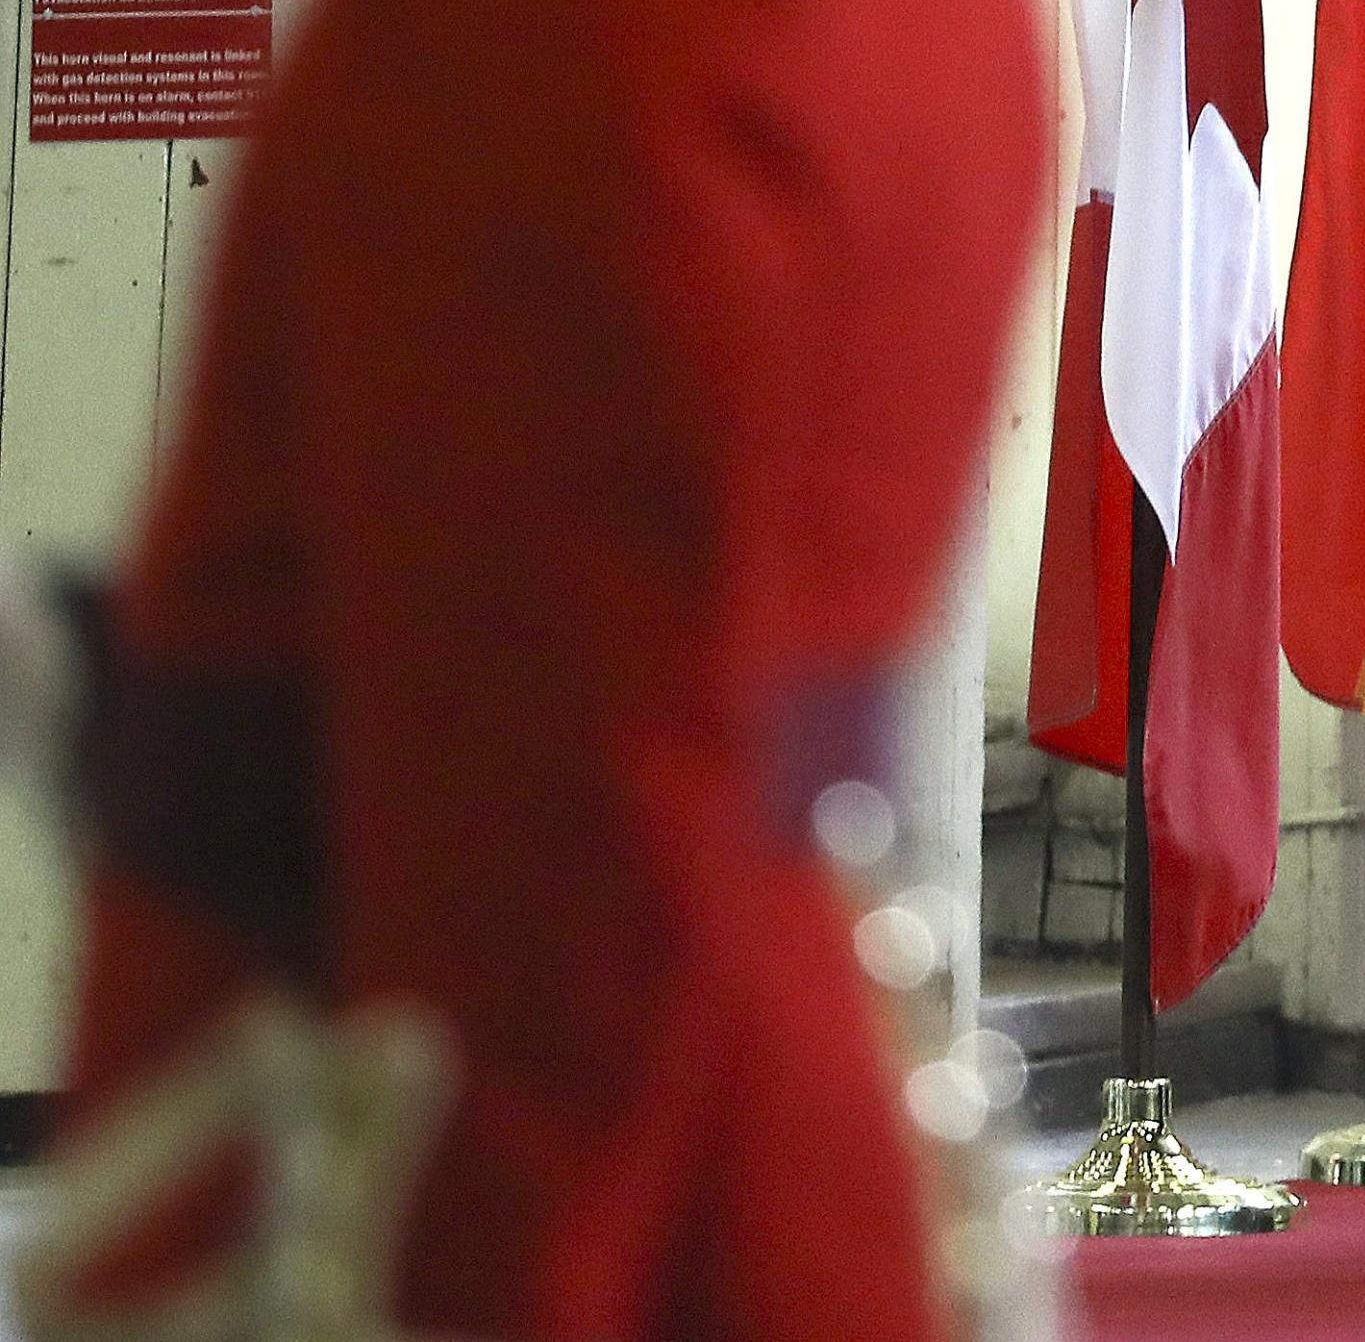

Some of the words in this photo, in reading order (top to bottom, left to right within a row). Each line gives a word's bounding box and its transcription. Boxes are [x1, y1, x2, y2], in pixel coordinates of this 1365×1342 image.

[34, 52, 59, 66] This
[62, 52, 89, 65] horn
[92, 50, 127, 64] visual
[130, 50, 152, 64] and
[155, 51, 208, 63] resonant
[211, 50, 221, 61] is
[224, 49, 261, 61] linked
[34, 72, 59, 85] with
[62, 74, 83, 88] gas
[86, 71, 143, 84] detection
[146, 71, 195, 85] systems
[198, 69, 210, 81] in
[213, 68, 235, 81] this
[33, 92, 66, 105] When
[69, 91, 91, 103] this
[94, 91, 121, 104] horn
[124, 91, 135, 103] is
[33, 111, 54, 126] and
[57, 111, 106, 127] proceed
[109, 110, 135, 124] with
[138, 110, 186, 125] building
